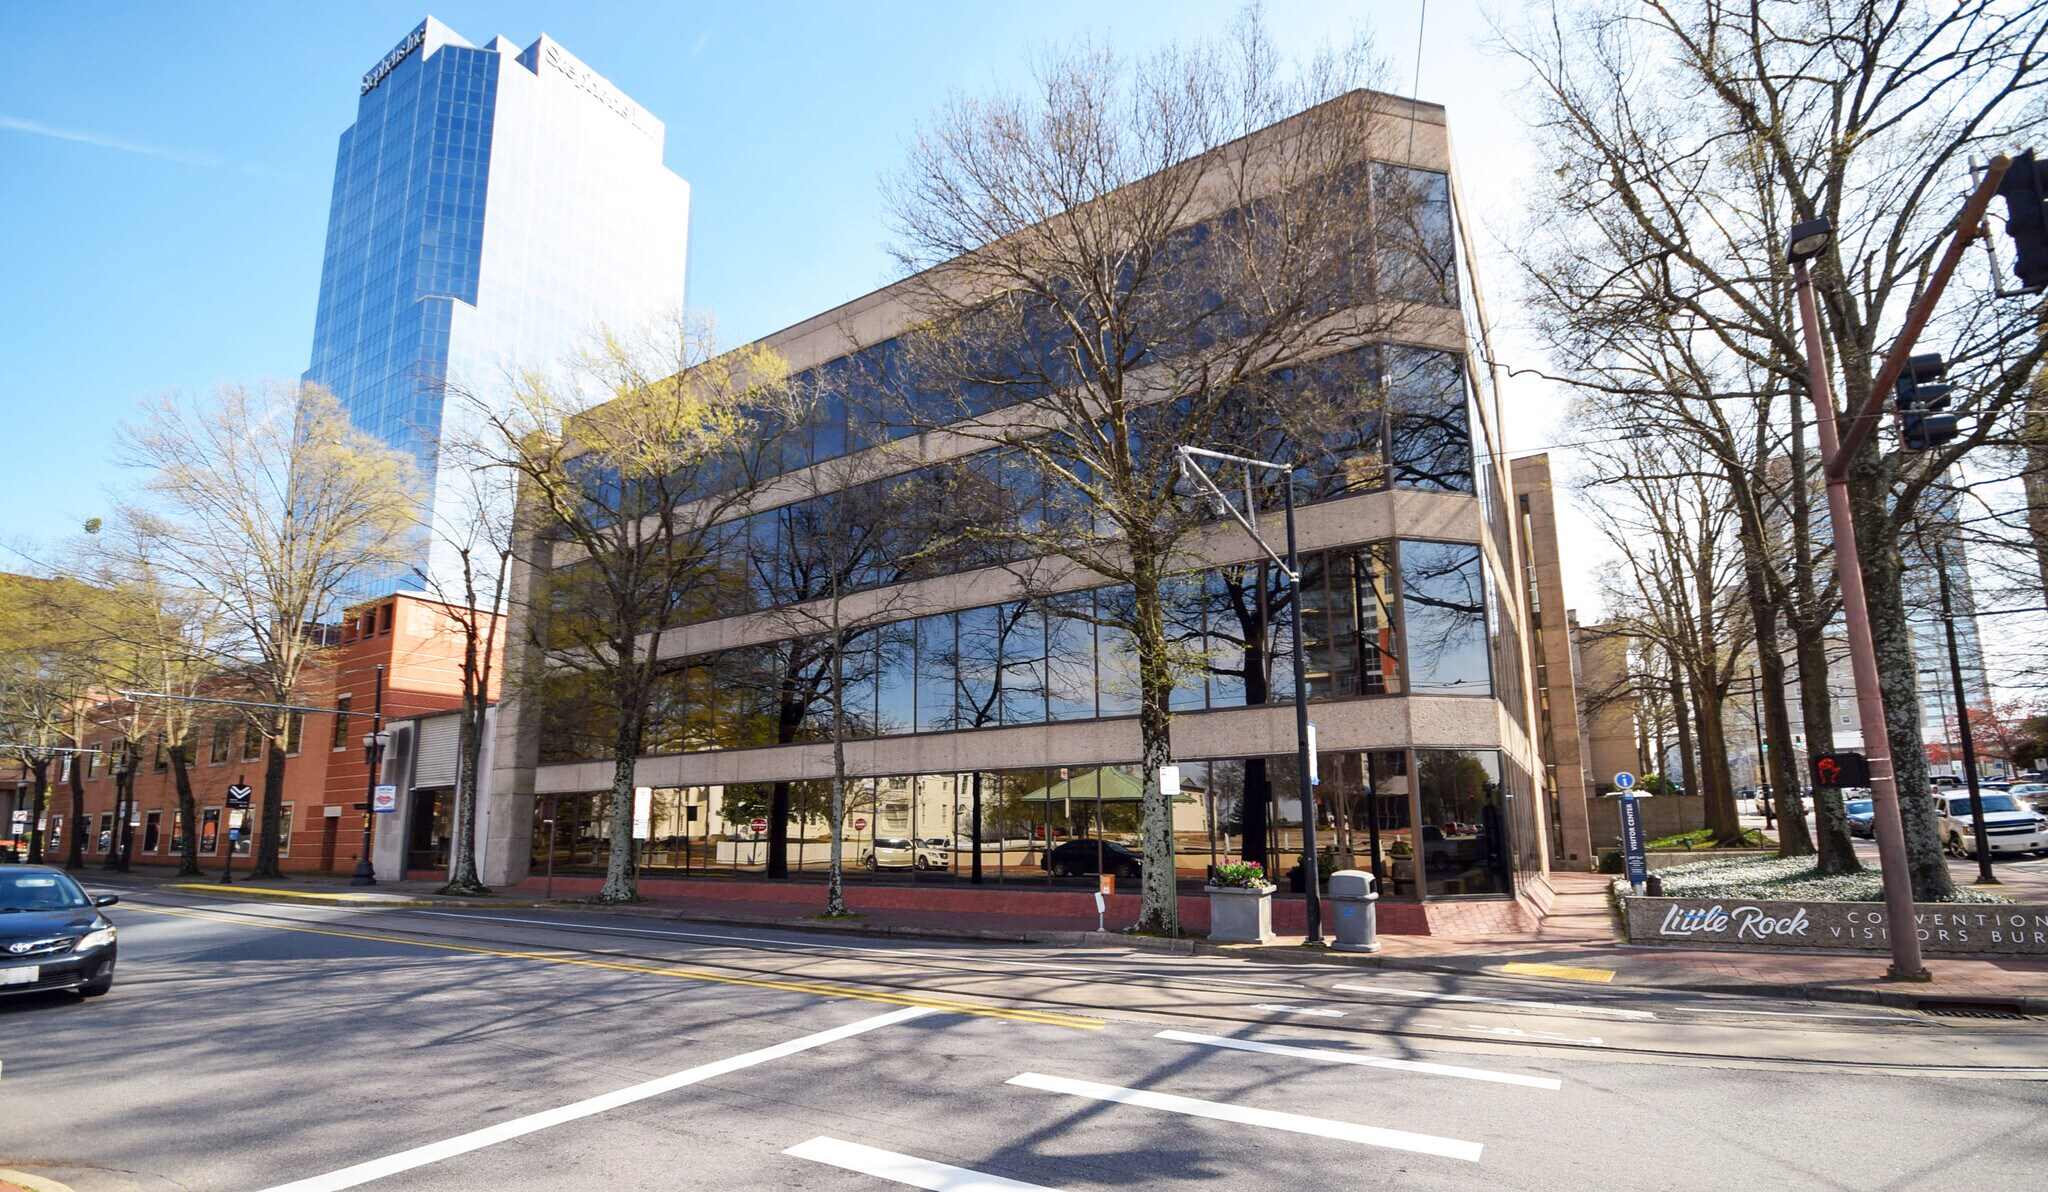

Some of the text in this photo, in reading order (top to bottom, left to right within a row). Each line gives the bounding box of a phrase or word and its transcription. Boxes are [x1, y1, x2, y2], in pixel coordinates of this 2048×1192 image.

[361, 45, 408, 96] Stephens
[1626, 803, 1635, 827] CENTER
[1628, 827, 1638, 851] VISITOR
[1659, 903, 1810, 939] Little Rock
[1847, 911, 2048, 928] COVENTION
[1830, 926, 1968, 942] VISIORS
